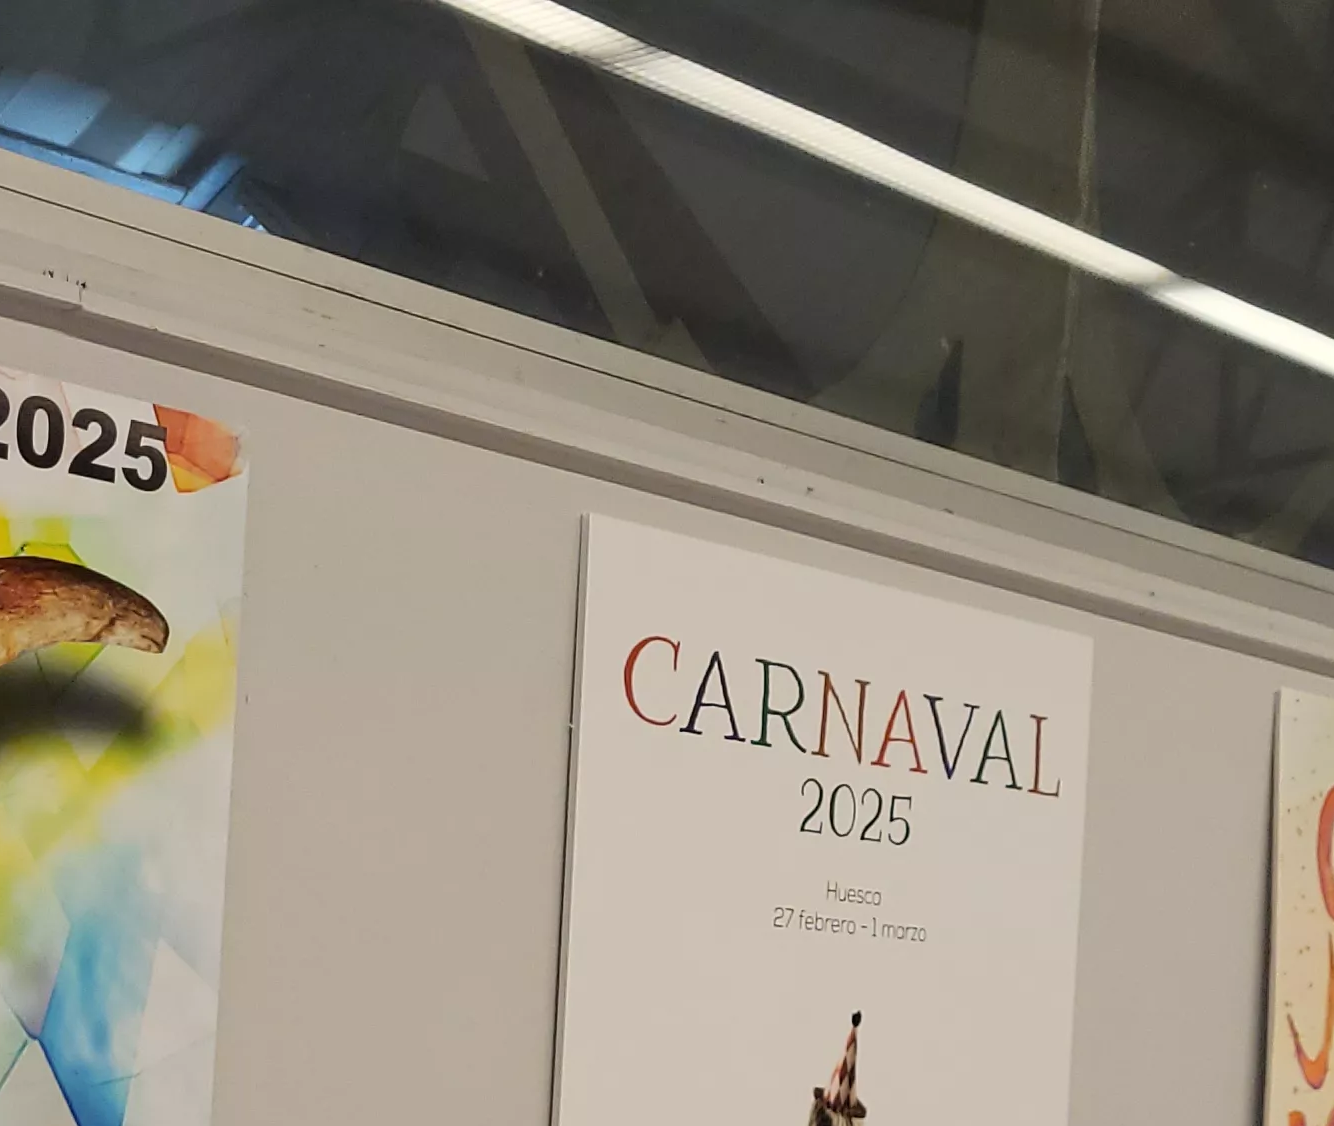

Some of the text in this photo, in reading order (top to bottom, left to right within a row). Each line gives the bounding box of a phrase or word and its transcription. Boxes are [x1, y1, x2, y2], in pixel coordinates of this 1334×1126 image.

[623, 636, 1062, 798] CARNAVAL
[799, 778, 913, 846] 2025
[825, 880, 882, 906] Huesca
[772, 906, 795, 929] 27
[799, 909, 857, 935] febrero
[871, 916, 878, 938] 1
[881, 923, 928, 942] marzo
